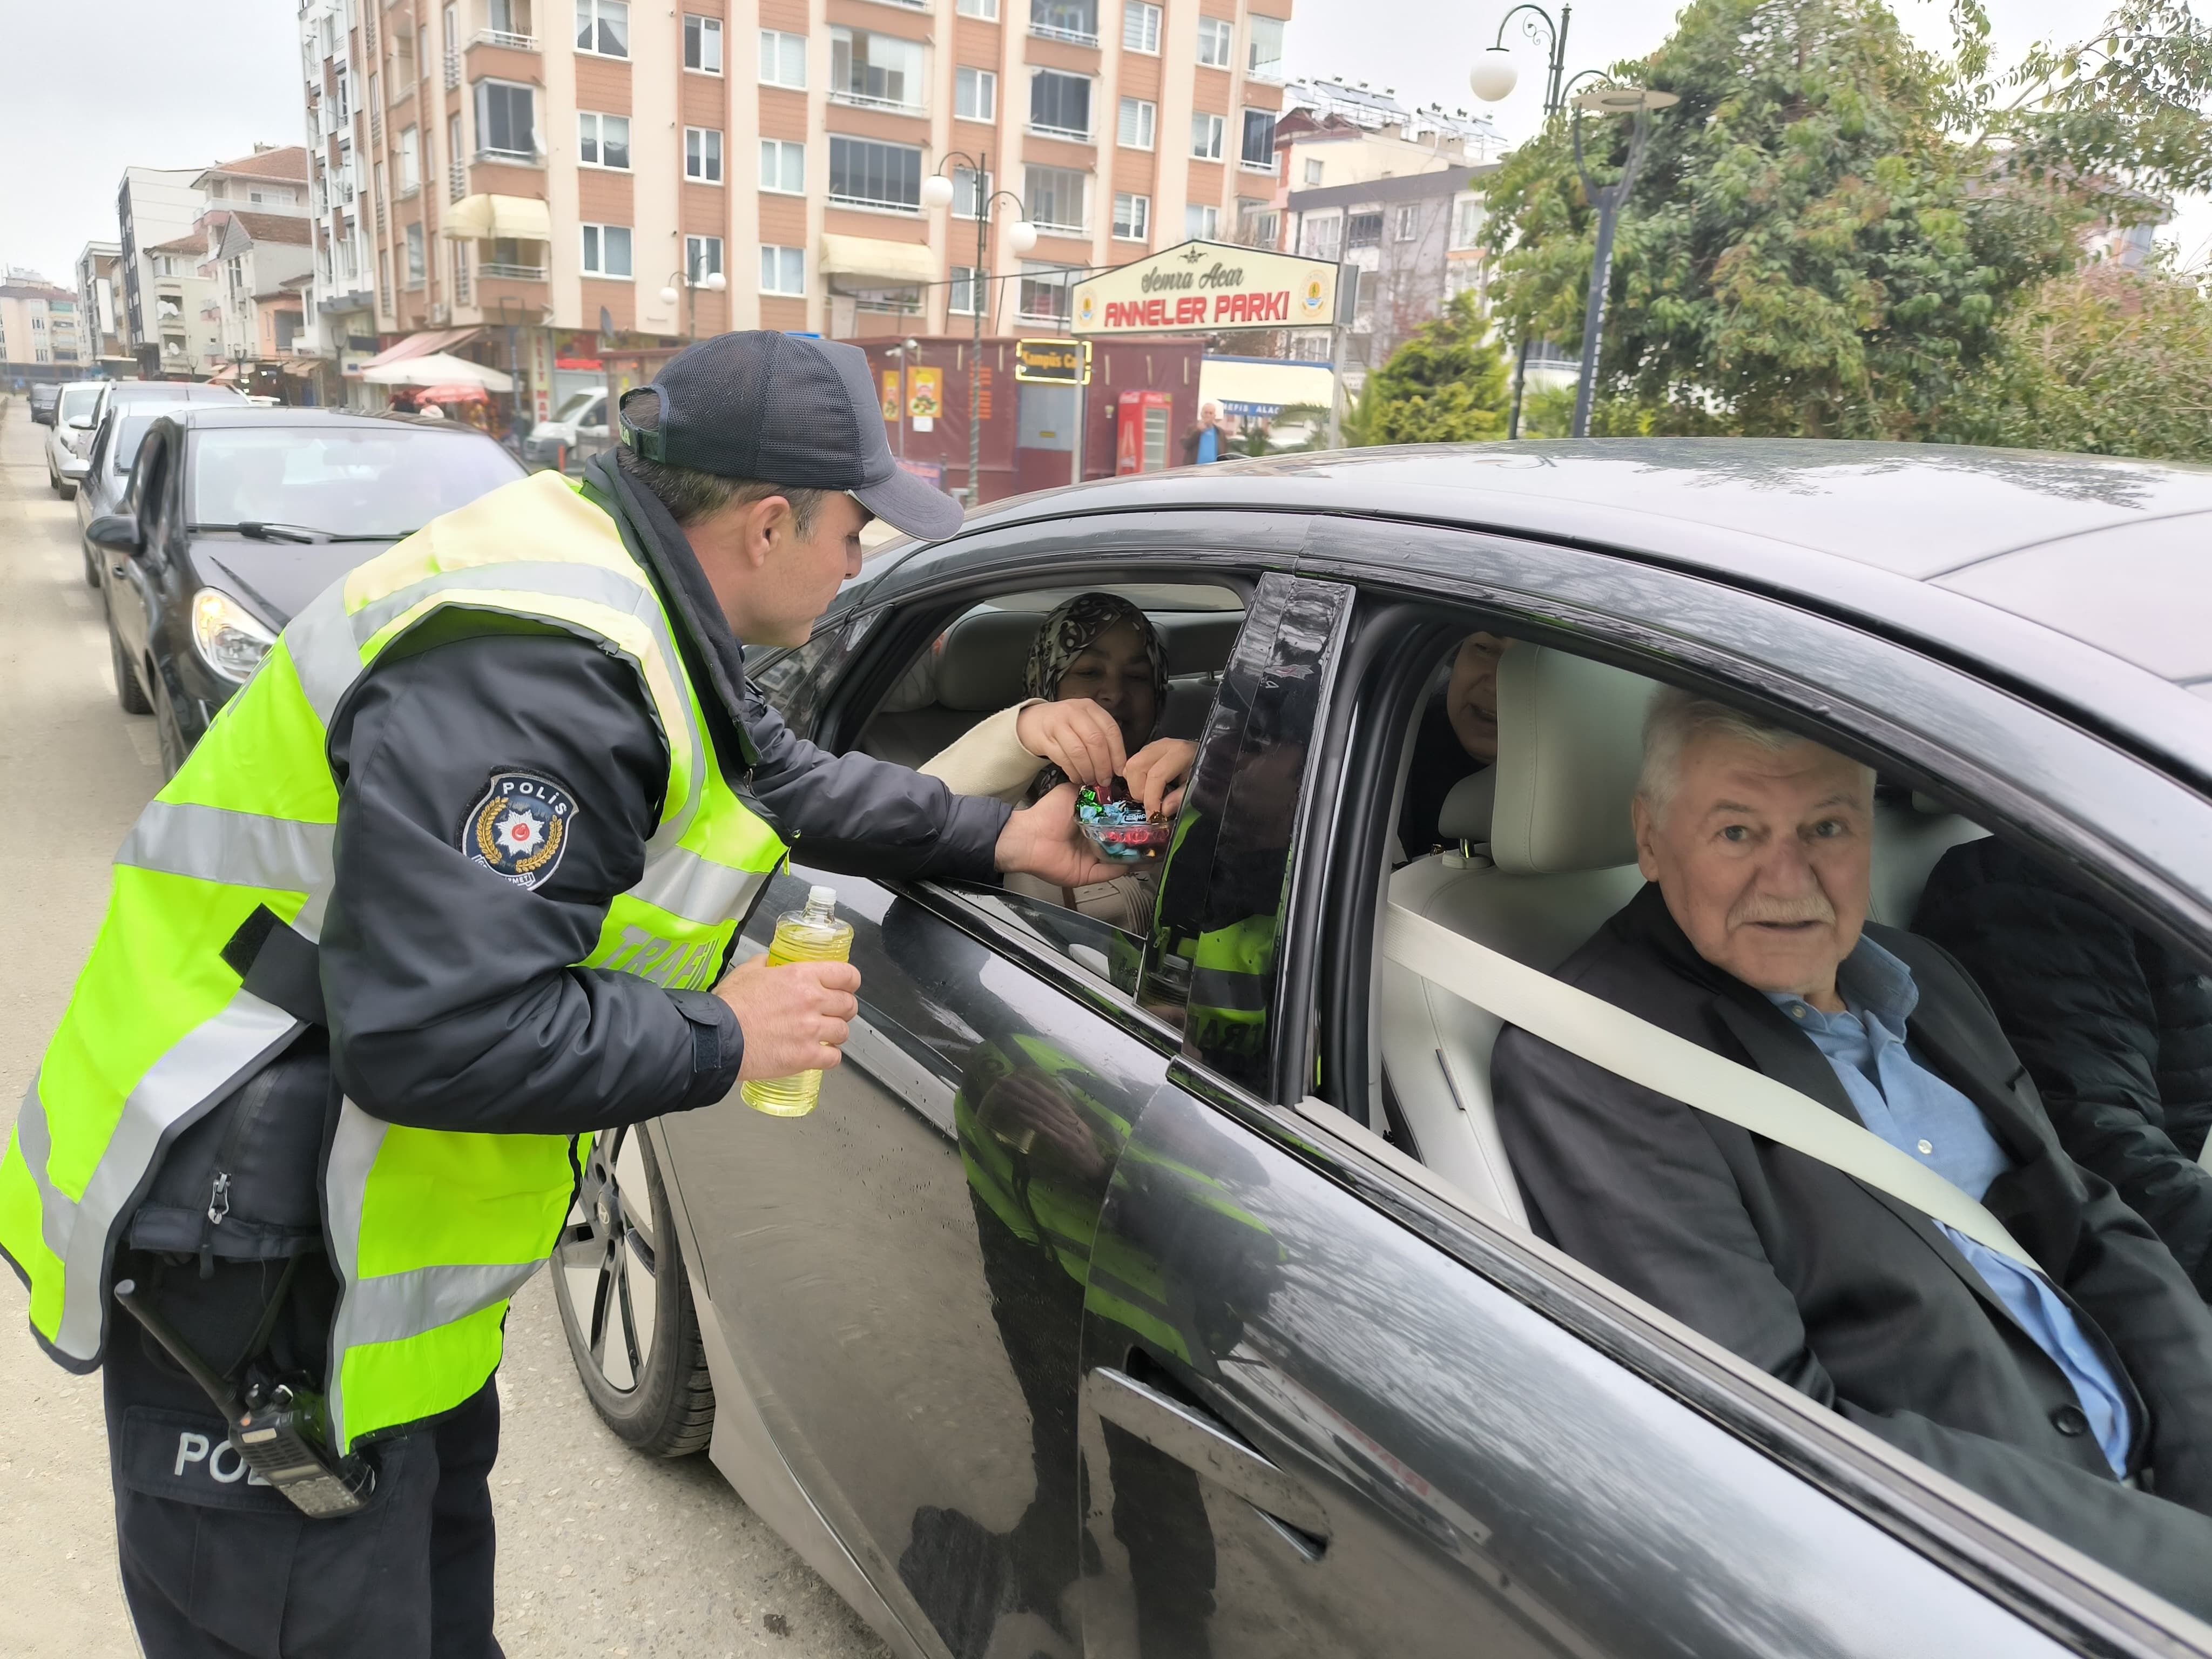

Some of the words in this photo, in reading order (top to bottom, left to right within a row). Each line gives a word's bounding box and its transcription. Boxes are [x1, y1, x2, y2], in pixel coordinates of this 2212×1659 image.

[1141, 266, 1194, 293] Semra
[1199, 262, 1244, 289] Acar
[1104, 296, 1207, 327] ANNELER
[1213, 291, 1290, 322] PARKI
[502, 781, 568, 815] POLİS
